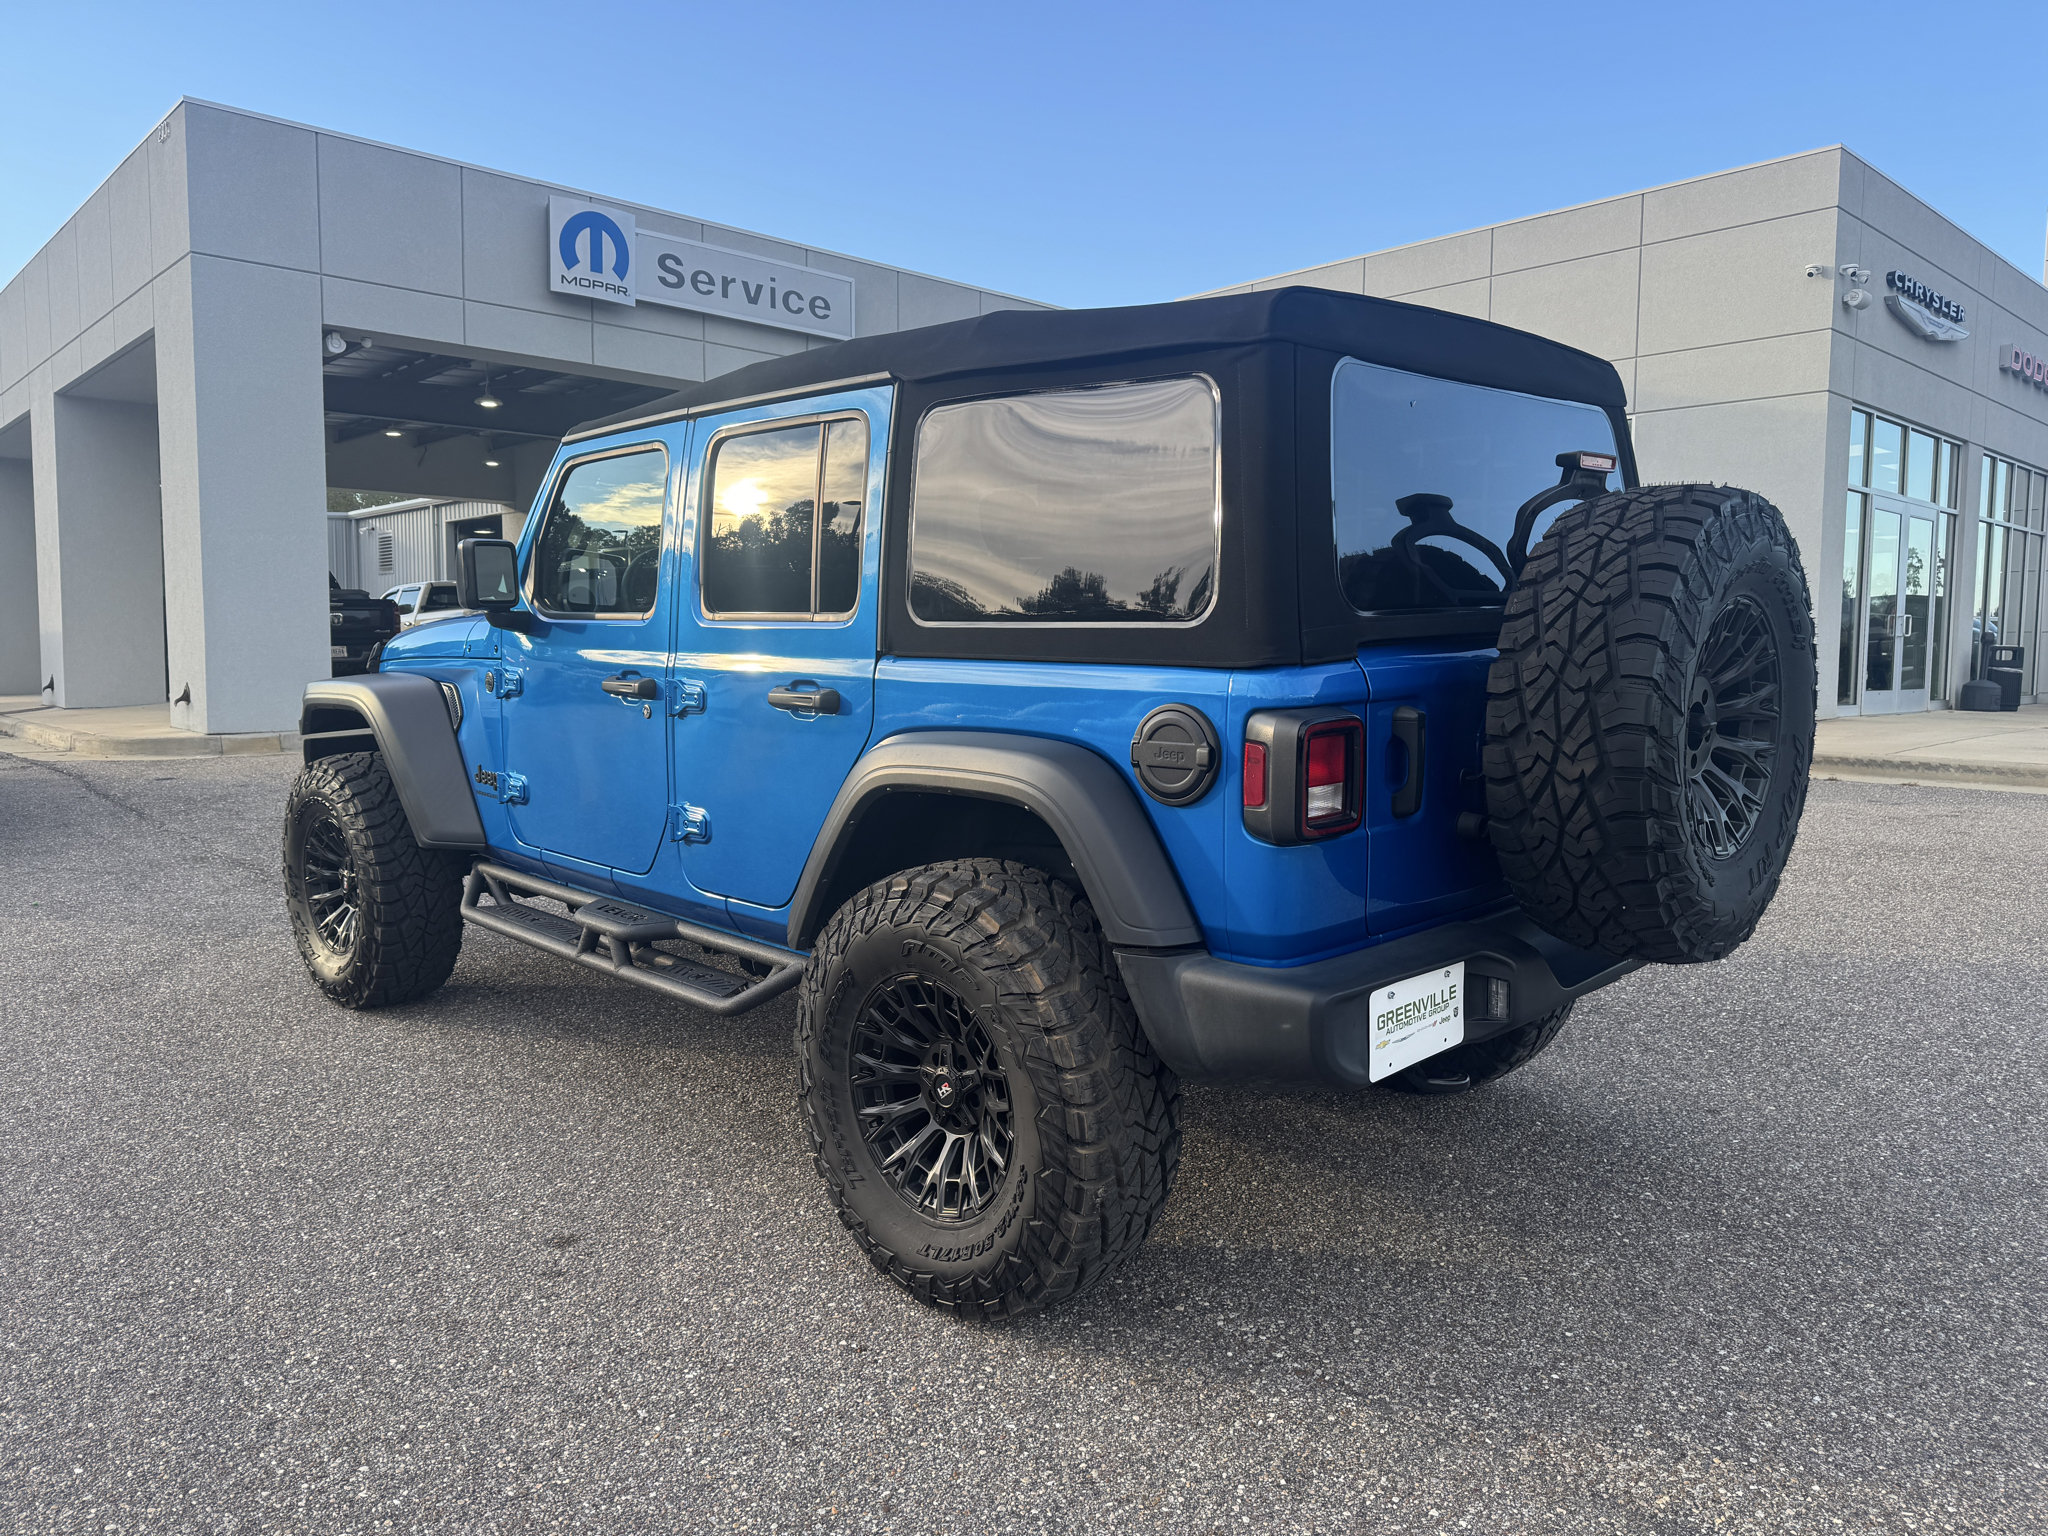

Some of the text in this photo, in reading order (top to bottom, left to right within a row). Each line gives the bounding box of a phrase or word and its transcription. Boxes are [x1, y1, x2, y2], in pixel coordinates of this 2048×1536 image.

[561, 274, 629, 297] MOPAR
[657, 253, 831, 320] Service
[1895, 270, 1965, 321] CHRYSLER
[1154, 747, 1185, 764] Jeep
[474, 764, 497, 791] Jeep
[1377, 984, 1457, 1031] GREENVILLE
[1385, 1011, 1427, 1036] AUTOMOTIVE
[1428, 1002, 1450, 1018] GROUP
[1438, 1015, 1451, 1025] Jeep
